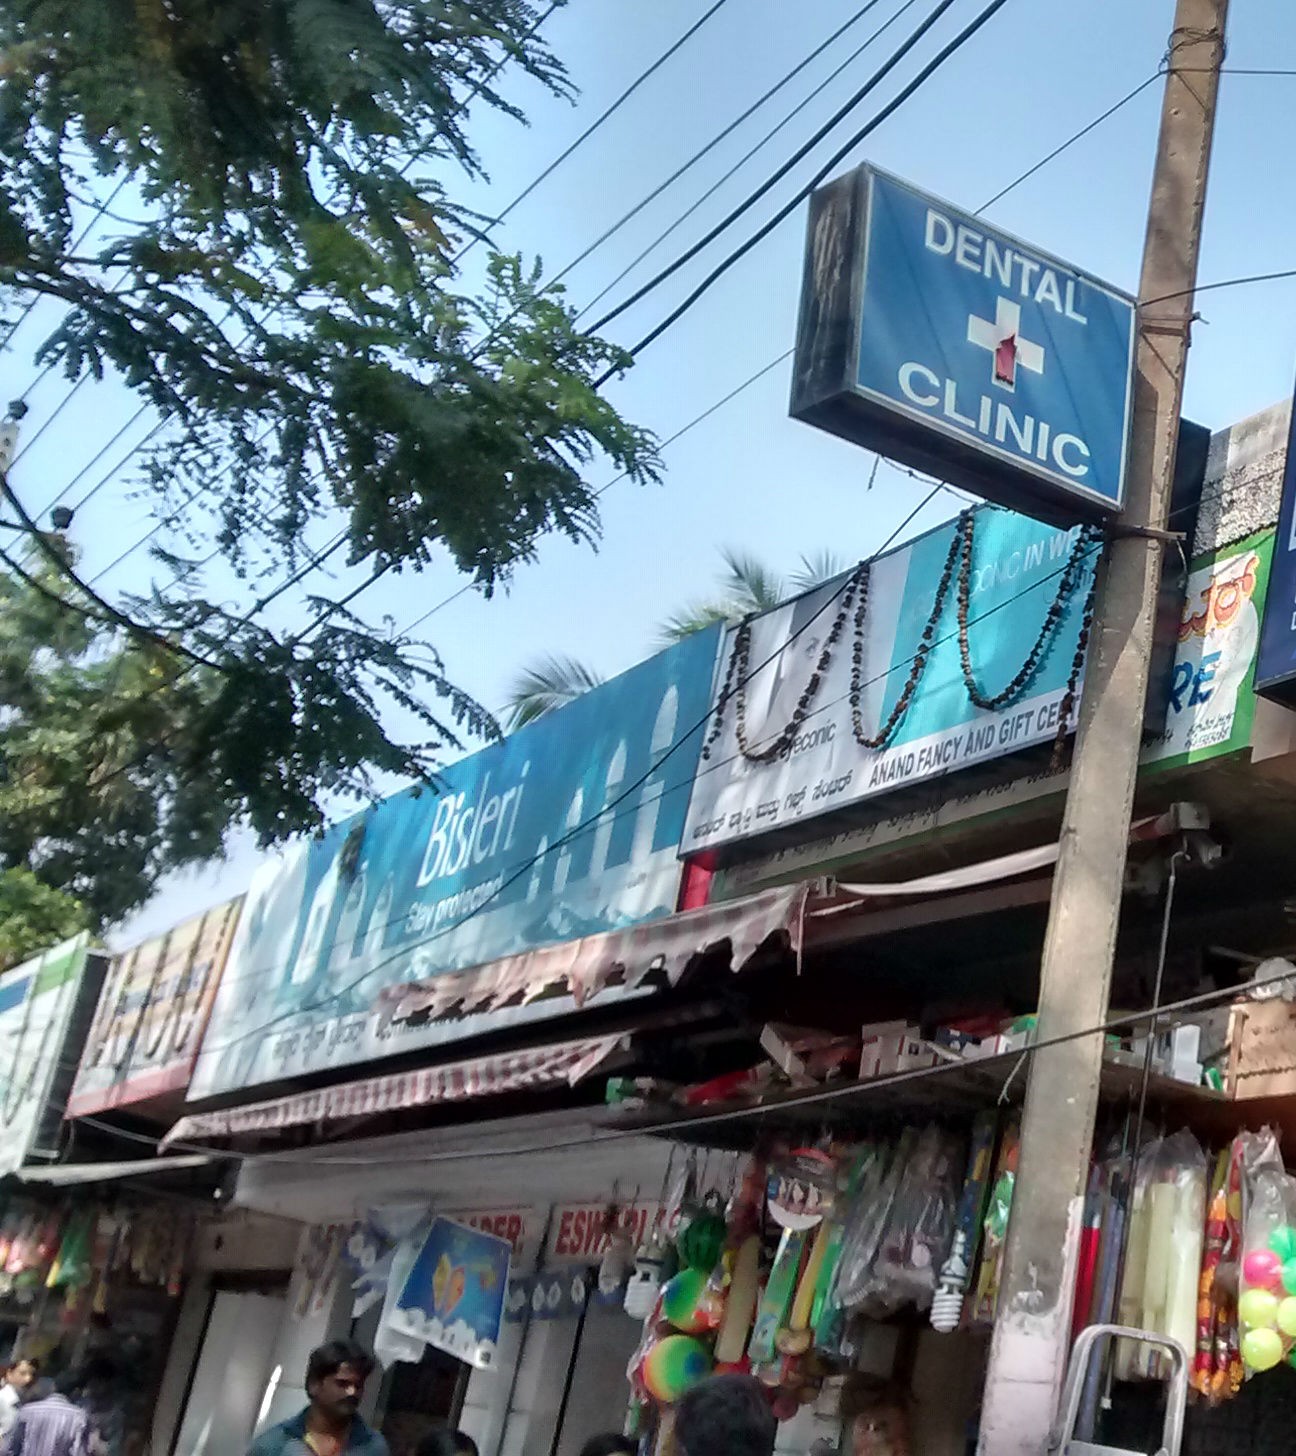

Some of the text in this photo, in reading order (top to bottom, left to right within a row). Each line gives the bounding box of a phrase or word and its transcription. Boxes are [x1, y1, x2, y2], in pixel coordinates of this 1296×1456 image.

[924, 207, 1087, 325] DENTAL
[898, 362, 1091, 477] CLINIC
[868, 750, 914, 788] ANAND
[916, 735, 963, 767] FANCY
[965, 720, 996, 753] AND
[999, 709, 1035, 745] GIFT
[416, 760, 531, 889] Bisleri
